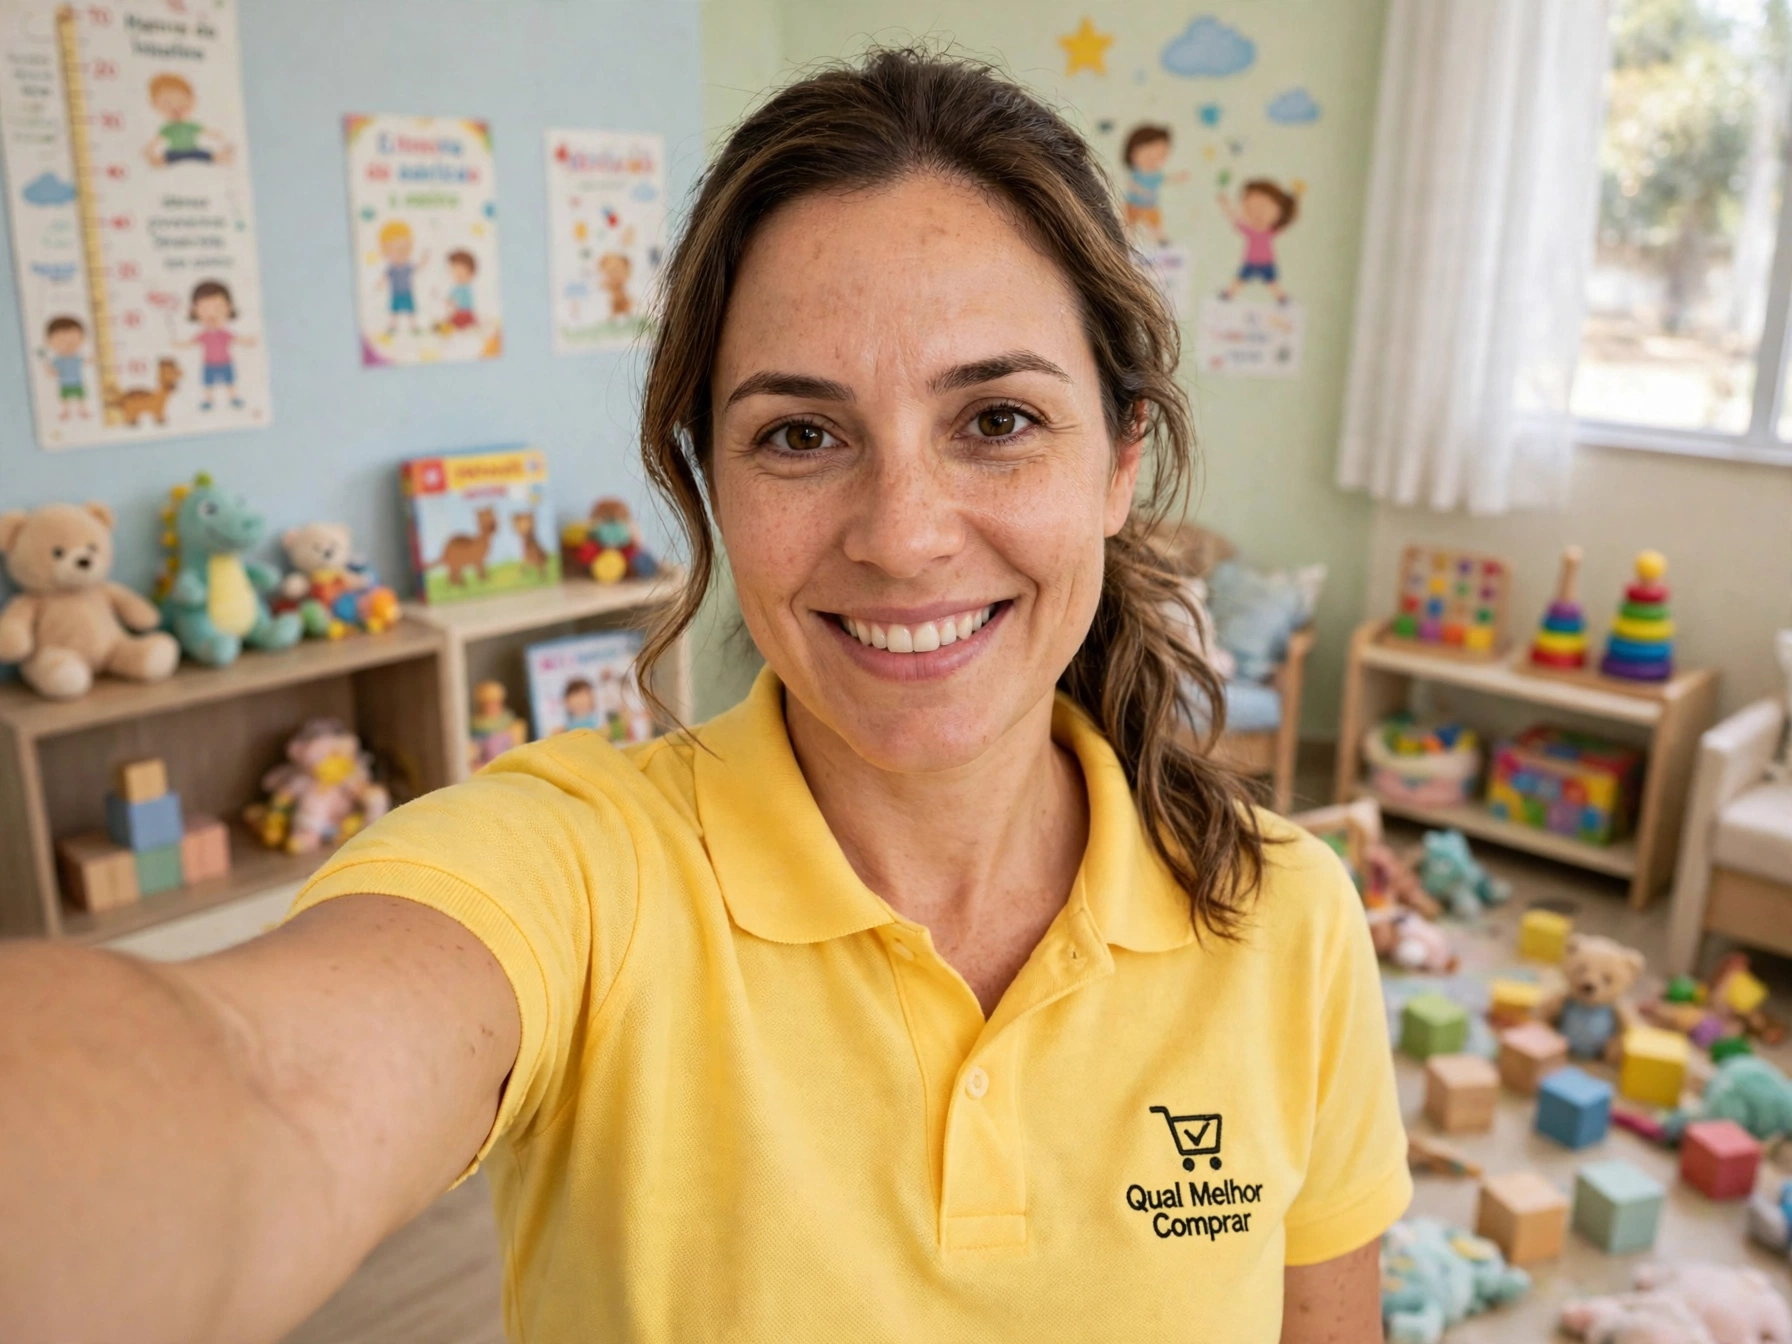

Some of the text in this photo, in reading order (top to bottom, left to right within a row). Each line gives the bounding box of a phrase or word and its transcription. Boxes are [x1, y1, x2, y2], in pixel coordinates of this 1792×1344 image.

[1126, 1178, 1263, 1213] Qual Melhor
[1152, 1212, 1252, 1242] Comprar
